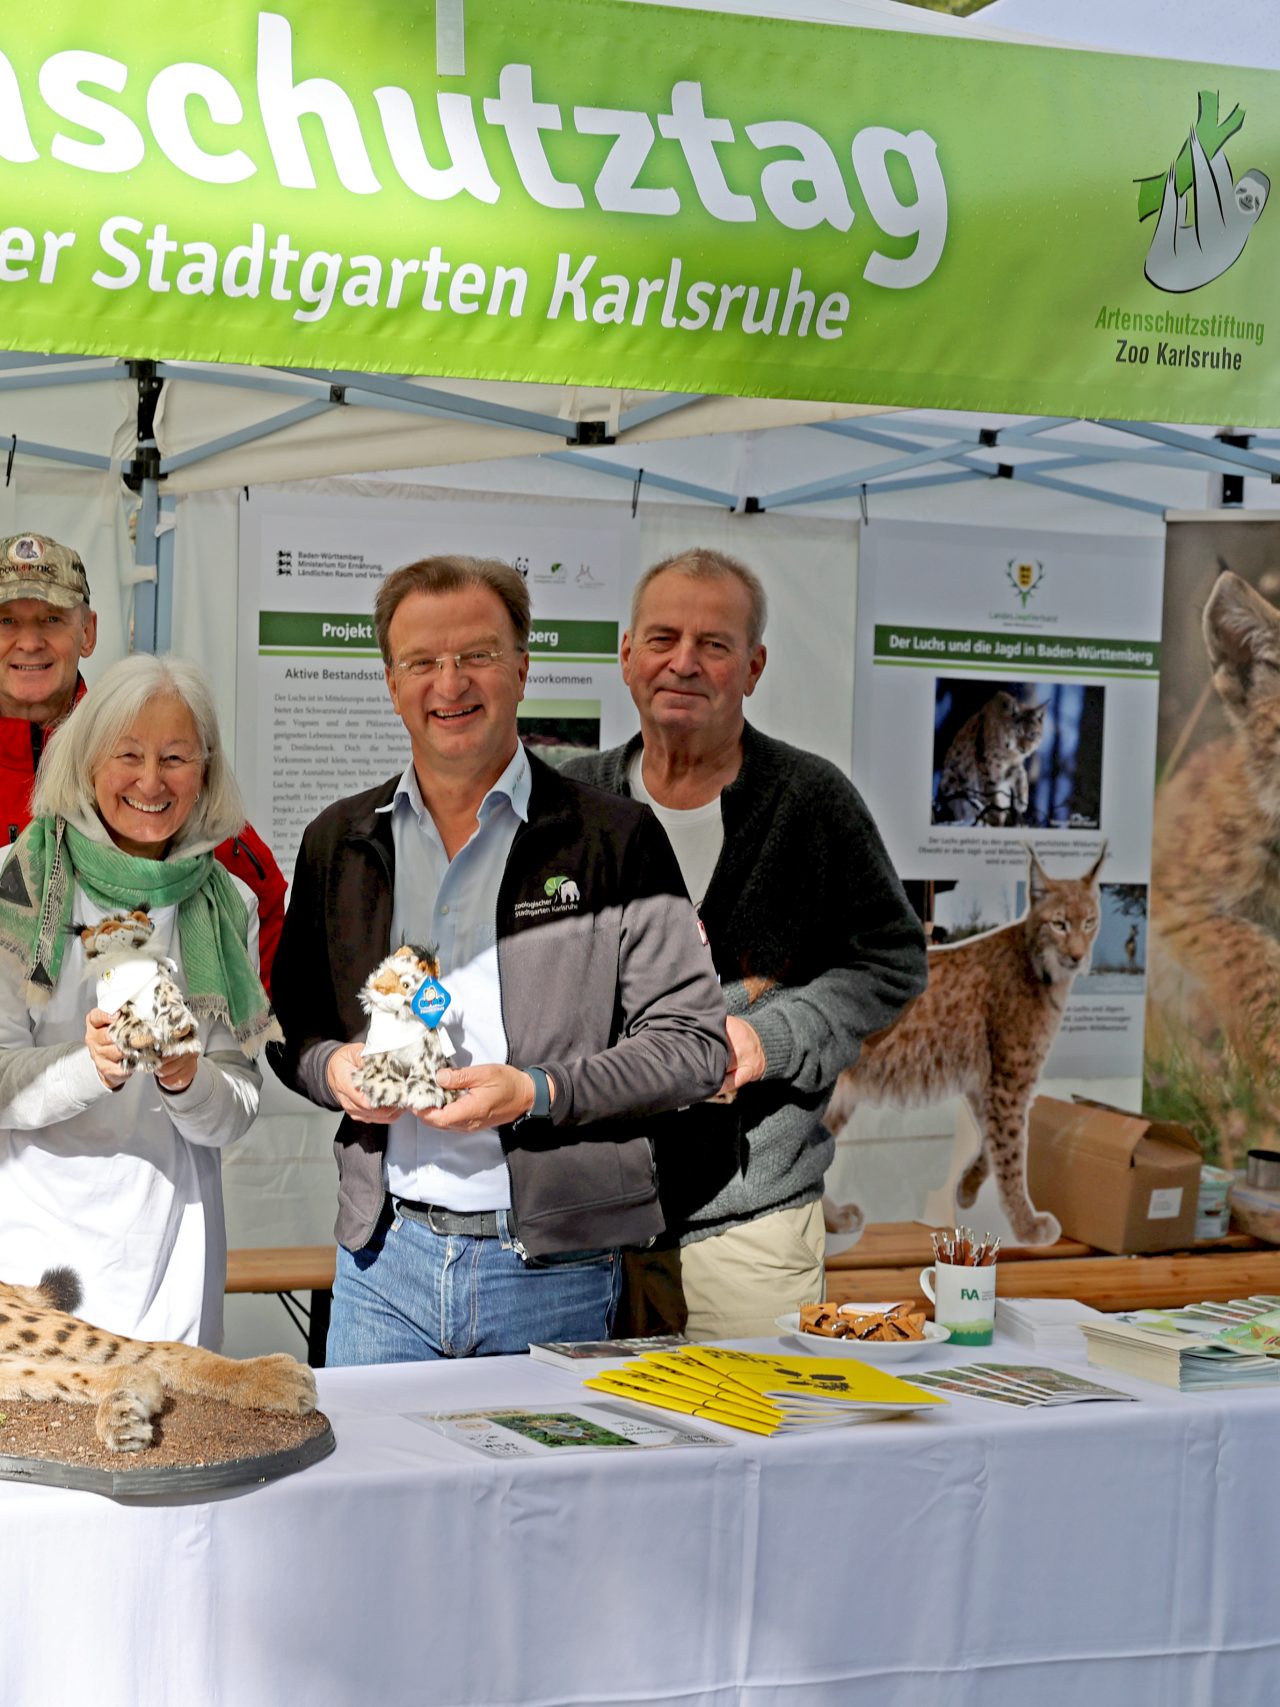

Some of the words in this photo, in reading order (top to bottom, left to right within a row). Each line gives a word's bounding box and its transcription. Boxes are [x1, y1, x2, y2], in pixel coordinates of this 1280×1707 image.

[92, 216, 528, 323] Stadtgarten
[547, 253, 851, 340] Karlsruhe
[1095, 305, 1265, 346] Artenschutzstiftung
[1116, 339, 1149, 365] Zoo
[1157, 342, 1242, 370] Karlsruhe
[322, 622, 372, 642] Projekt
[527, 630, 559, 647] berg
[889, 634, 911, 649] Der
[913, 636, 946, 651] Luchs
[948, 639, 971, 653] und
[976, 640, 992, 654] die
[994, 641, 1021, 658] Jagd
[1023, 642, 1036, 657] in
[1038, 643, 1154, 665] Baden-Württemberg
[284, 668, 319, 680] Aktive
[322, 669, 384, 681] Bestandsstü
[527, 673, 593, 685] svorkommen
